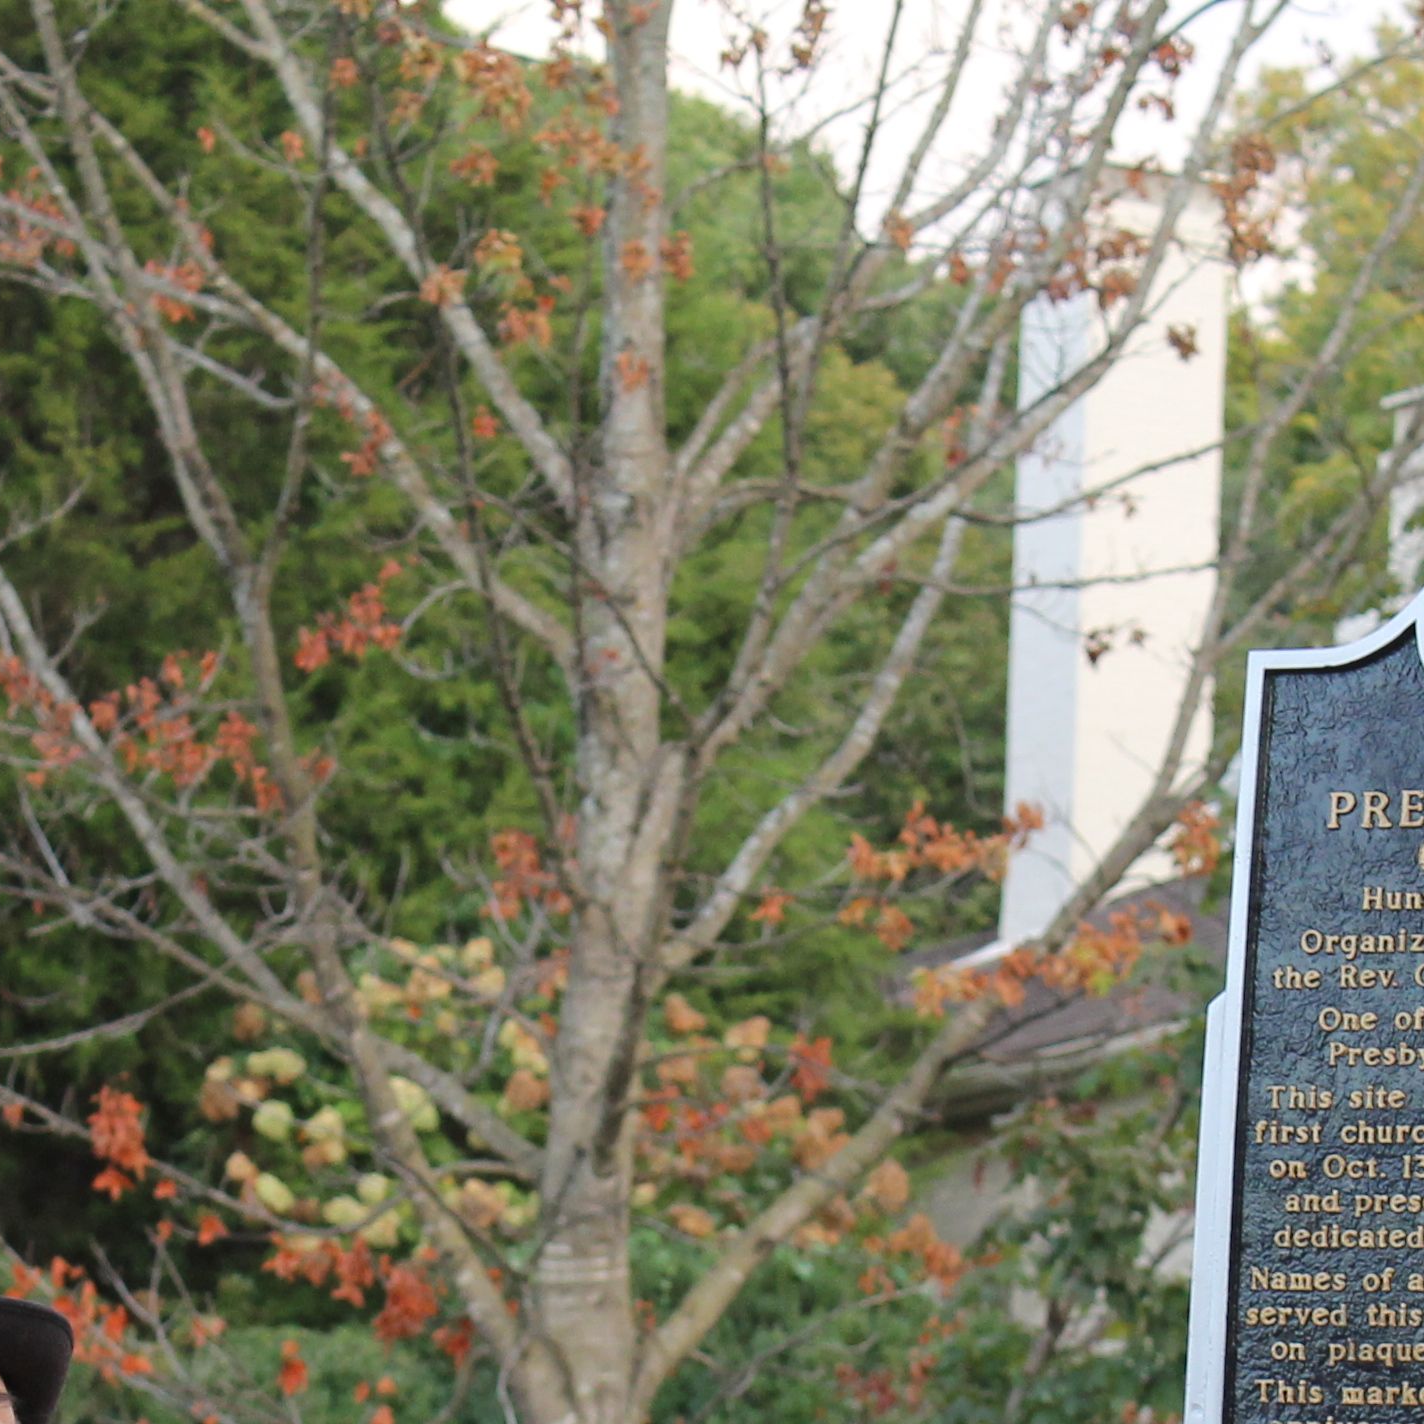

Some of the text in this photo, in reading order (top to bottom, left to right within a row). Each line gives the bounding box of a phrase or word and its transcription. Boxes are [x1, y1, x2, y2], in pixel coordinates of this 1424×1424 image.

[1273, 967, 1321, 989] the
[1340, 967, 1399, 989] Rev.
[1319, 1009, 1377, 1031] One
[1266, 1086, 1333, 1110] This
[1349, 1086, 1405, 1109] site
[1254, 1121, 1321, 1145] first
[1269, 1160, 1308, 1180] on
[1323, 1156, 1387, 1180] Oct.
[1285, 1191, 1341, 1214] and
[1274, 1226, 1424, 1250] dedicated
[1250, 1268, 1347, 1291] Names
[1362, 1268, 1394, 1291] of
[1244, 1302, 1348, 1327] served
[1366, 1304, 1424, 1328] this
[1271, 1342, 1306, 1361] on
[1254, 1379, 1324, 1404] This
